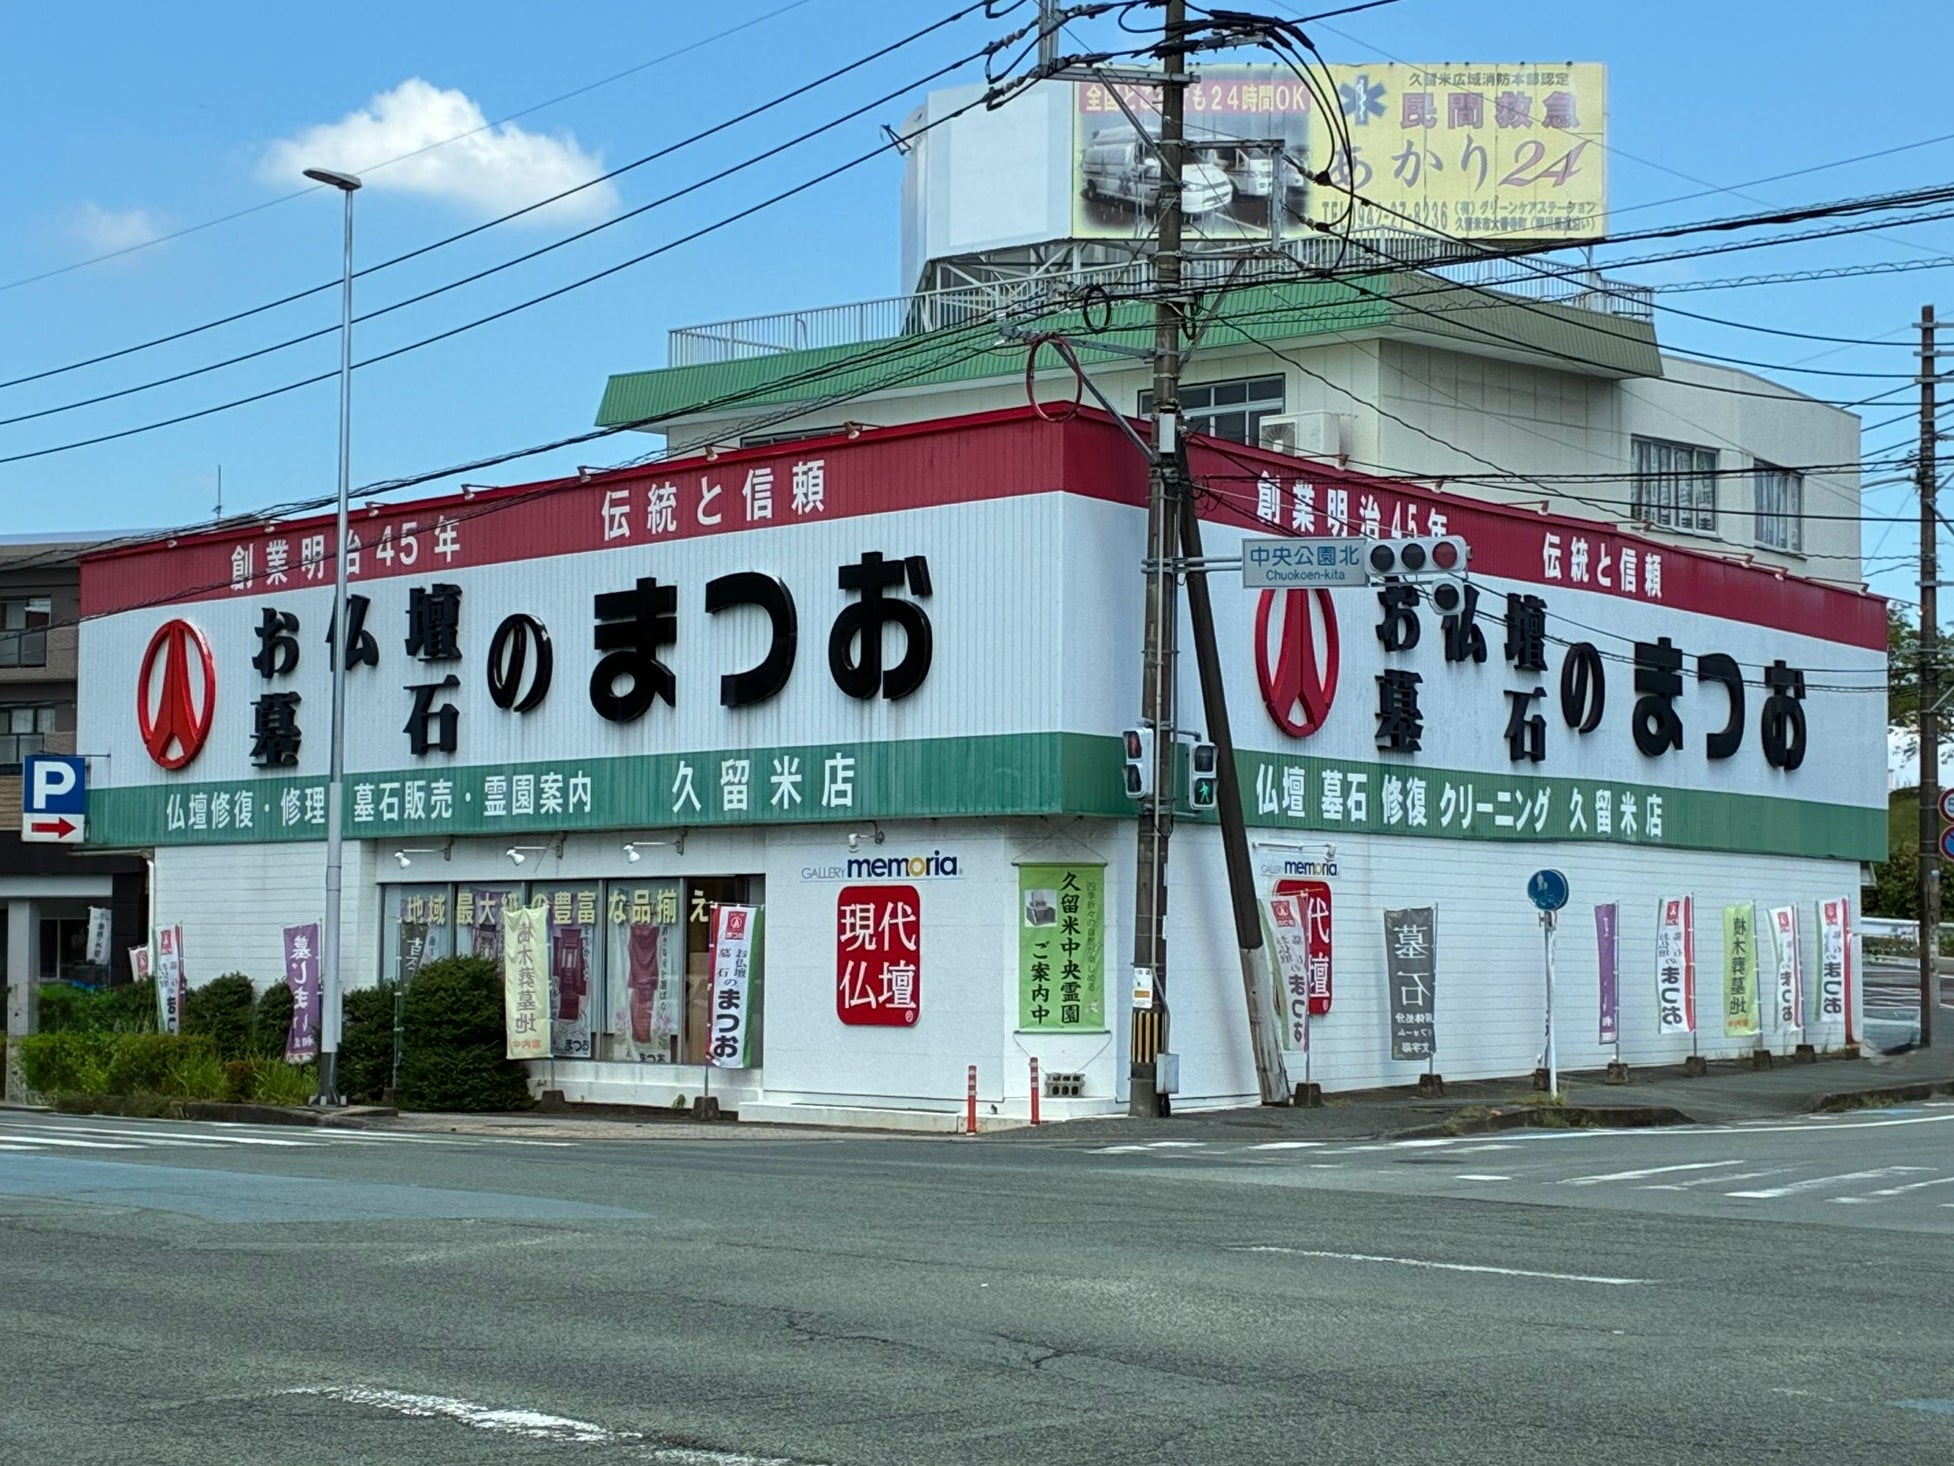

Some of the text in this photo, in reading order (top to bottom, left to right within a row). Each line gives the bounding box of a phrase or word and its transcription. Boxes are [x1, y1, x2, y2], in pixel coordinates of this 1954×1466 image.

[1400, 91, 1581, 129] 民間救急
[602, 459, 826, 541] 伝統と信頼
[1257, 469, 1447, 540] 創業明治45年
[1250, 545, 1360, 567] 中央公園北
[1265, 569, 1346, 581] Chuokoen-kita
[1543, 531, 1663, 598] 伝統と信頼
[251, 583, 463, 679] お仏壇
[1375, 576, 1549, 673] お仏壇
[250, 674, 460, 769] 墓石
[1375, 668, 1549, 762] 墓石
[33, 761, 76, 809] P
[671, 752, 856, 815] 久留米店
[1256, 763, 1663, 837] 仏壇 墓石 修復 クリーニング 久留米店
[801, 850, 957, 879] GALLERY memoria
[840, 901, 917, 951] 現代
[1060, 871, 1081, 1024] 久留米中央霊園
[717, 949, 731, 978] 墓石
[733, 948, 748, 978] お仏壇
[840, 959, 917, 1009] 仏壇
[1030, 940, 1051, 1025] ご案内中
